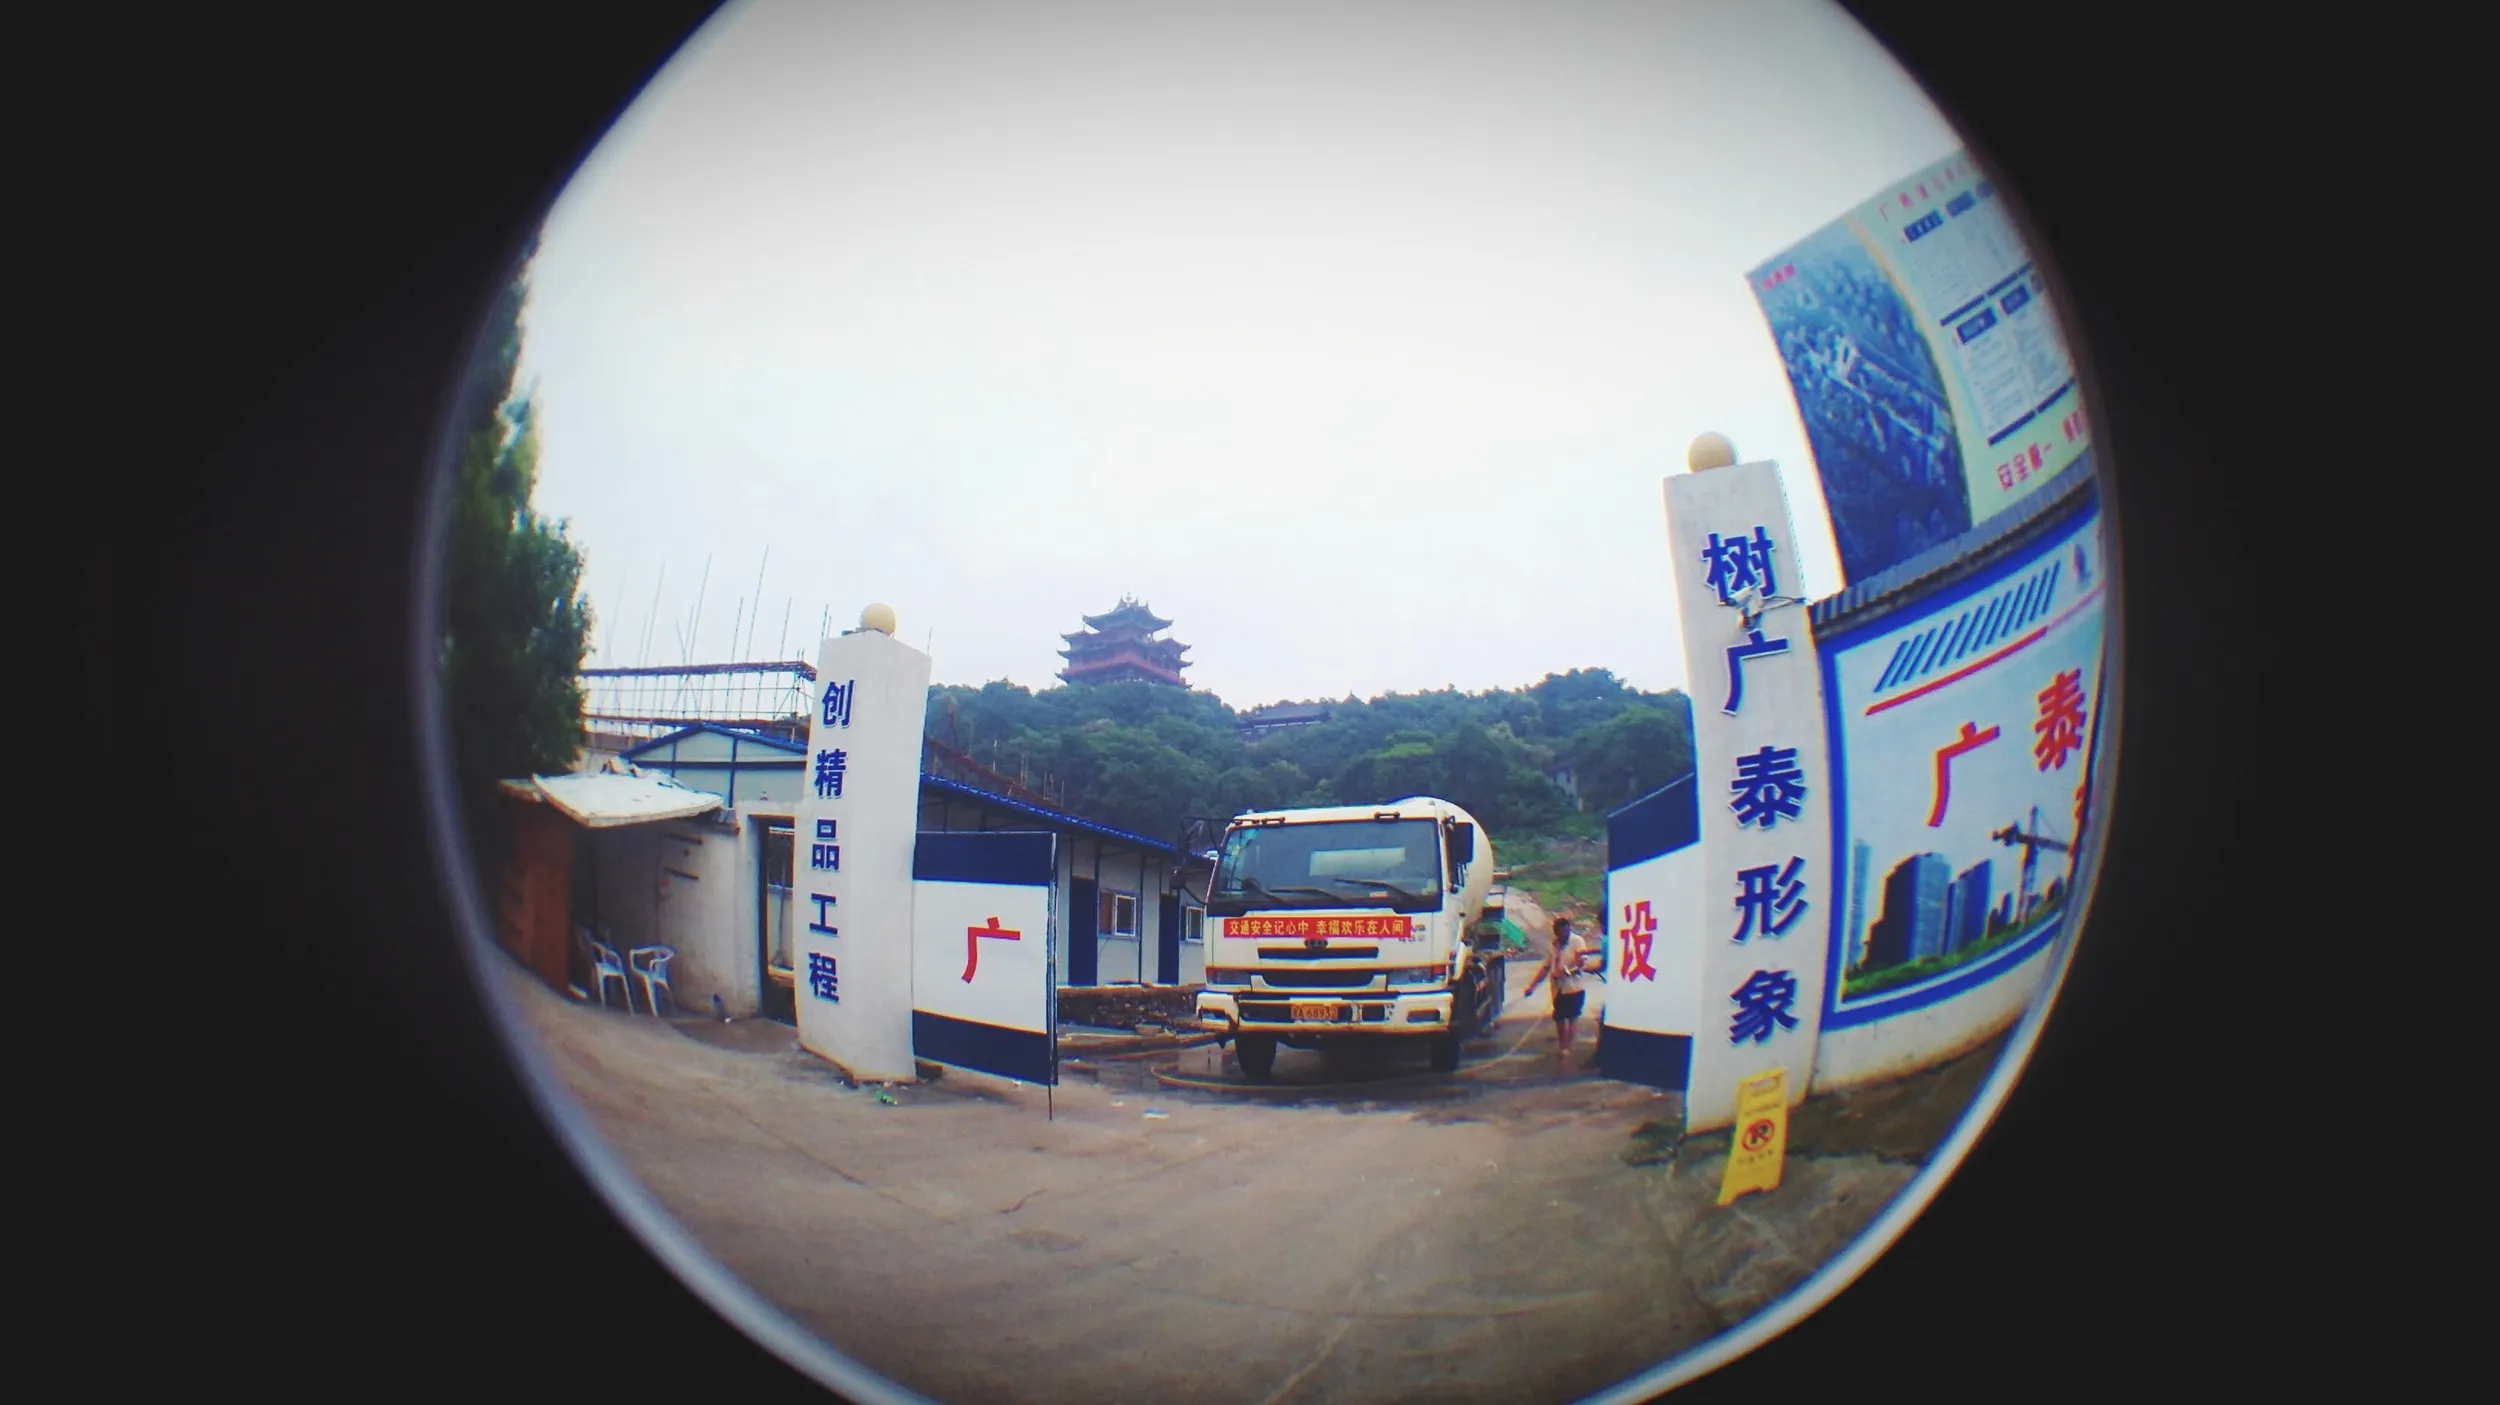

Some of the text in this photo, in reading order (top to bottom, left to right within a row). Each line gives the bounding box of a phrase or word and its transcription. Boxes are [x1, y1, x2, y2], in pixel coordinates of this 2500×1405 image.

[1702, 526, 1808, 1044] 树广泰形象
[808, 679, 854, 1003] 创精品工程
[962, 917, 1020, 984] 广
[1230, 919, 1309, 935] 交通安全记心中
[1316, 919, 1405, 936] 幸福欢乐在人间
[1620, 900, 1658, 982] 设
